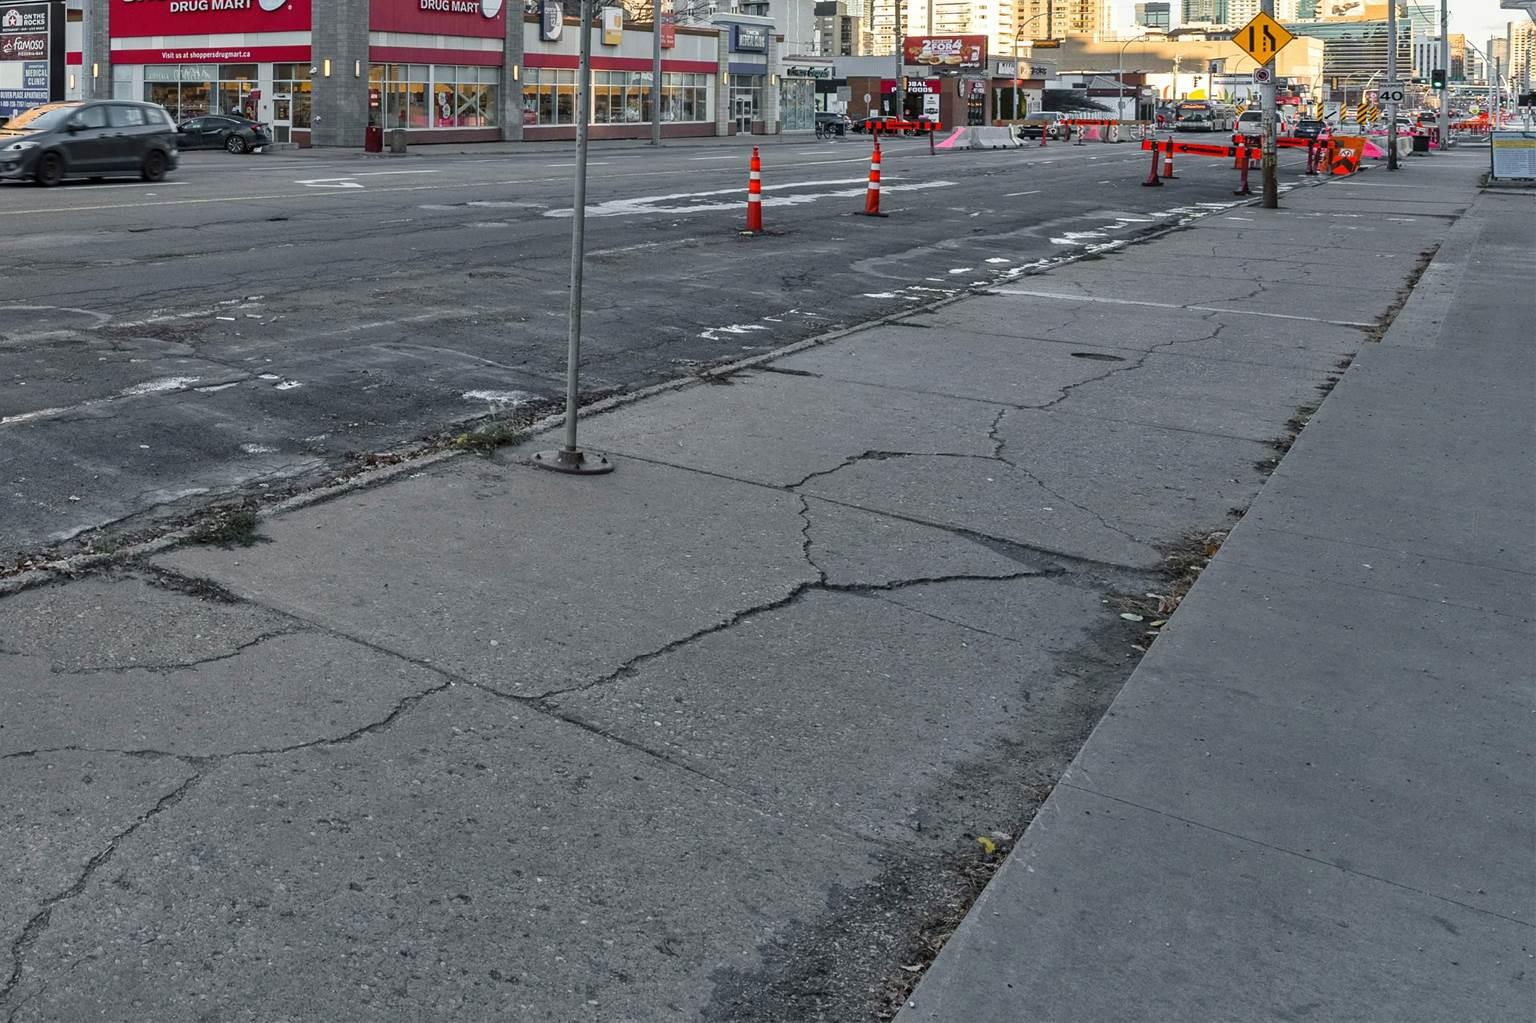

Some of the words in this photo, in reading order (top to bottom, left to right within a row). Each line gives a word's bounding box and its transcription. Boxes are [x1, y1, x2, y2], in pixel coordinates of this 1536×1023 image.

[170, 0, 209, 13] DRUG
[451, 0, 480, 14] MART
[162, 51, 175, 60] Visit
[190, 50, 251, 60] shoppersdrugmart.ca
[25, 68, 48, 77] MEDICAL
[27, 77, 46, 86] CLINIC
[1380, 91, 1403, 101] 40
